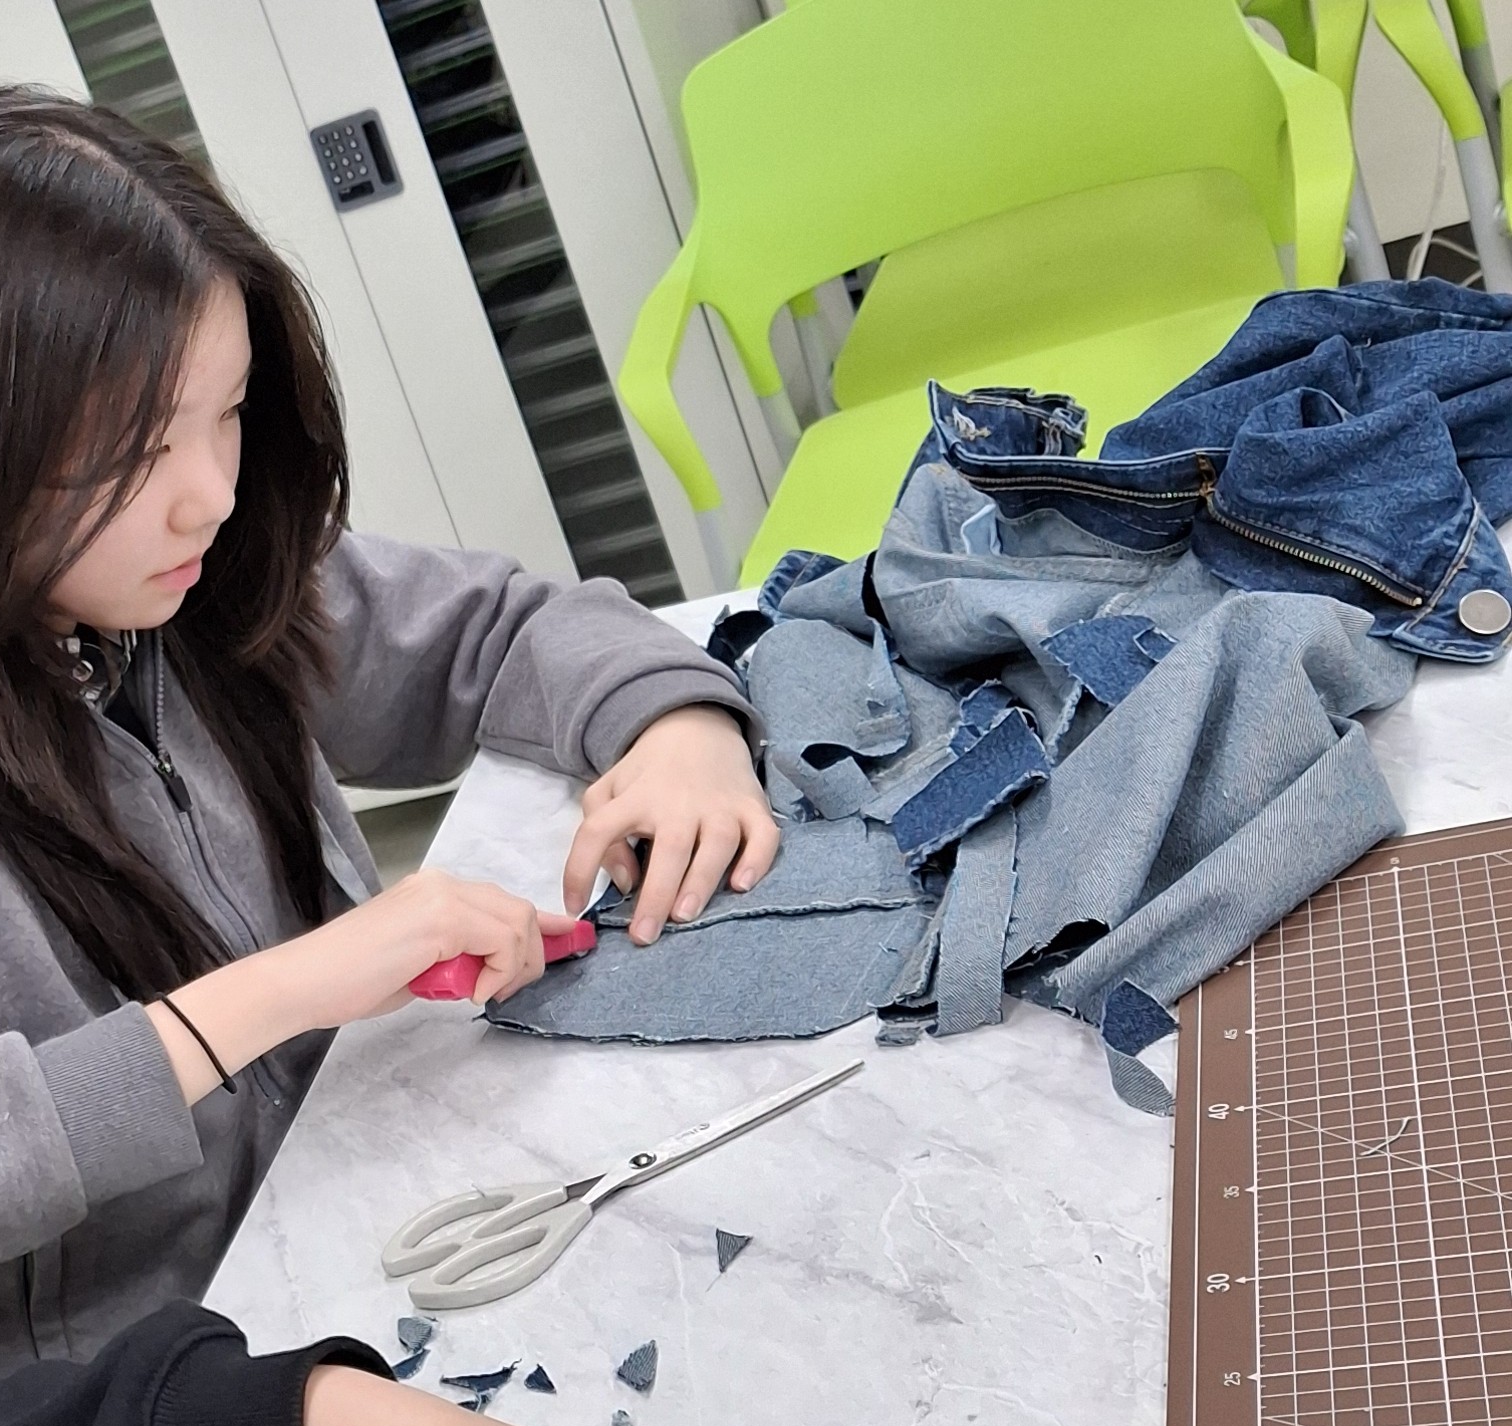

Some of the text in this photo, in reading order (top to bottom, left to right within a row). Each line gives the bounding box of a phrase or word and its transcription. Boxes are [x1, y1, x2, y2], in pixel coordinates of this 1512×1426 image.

[1224, 1028, 1238, 1040] 45
[1208, 1103, 1230, 1120] 40
[1223, 1185, 1240, 1200] 35
[1206, 1273, 1230, 1294] 30
[1223, 1371, 1241, 1387] 25
